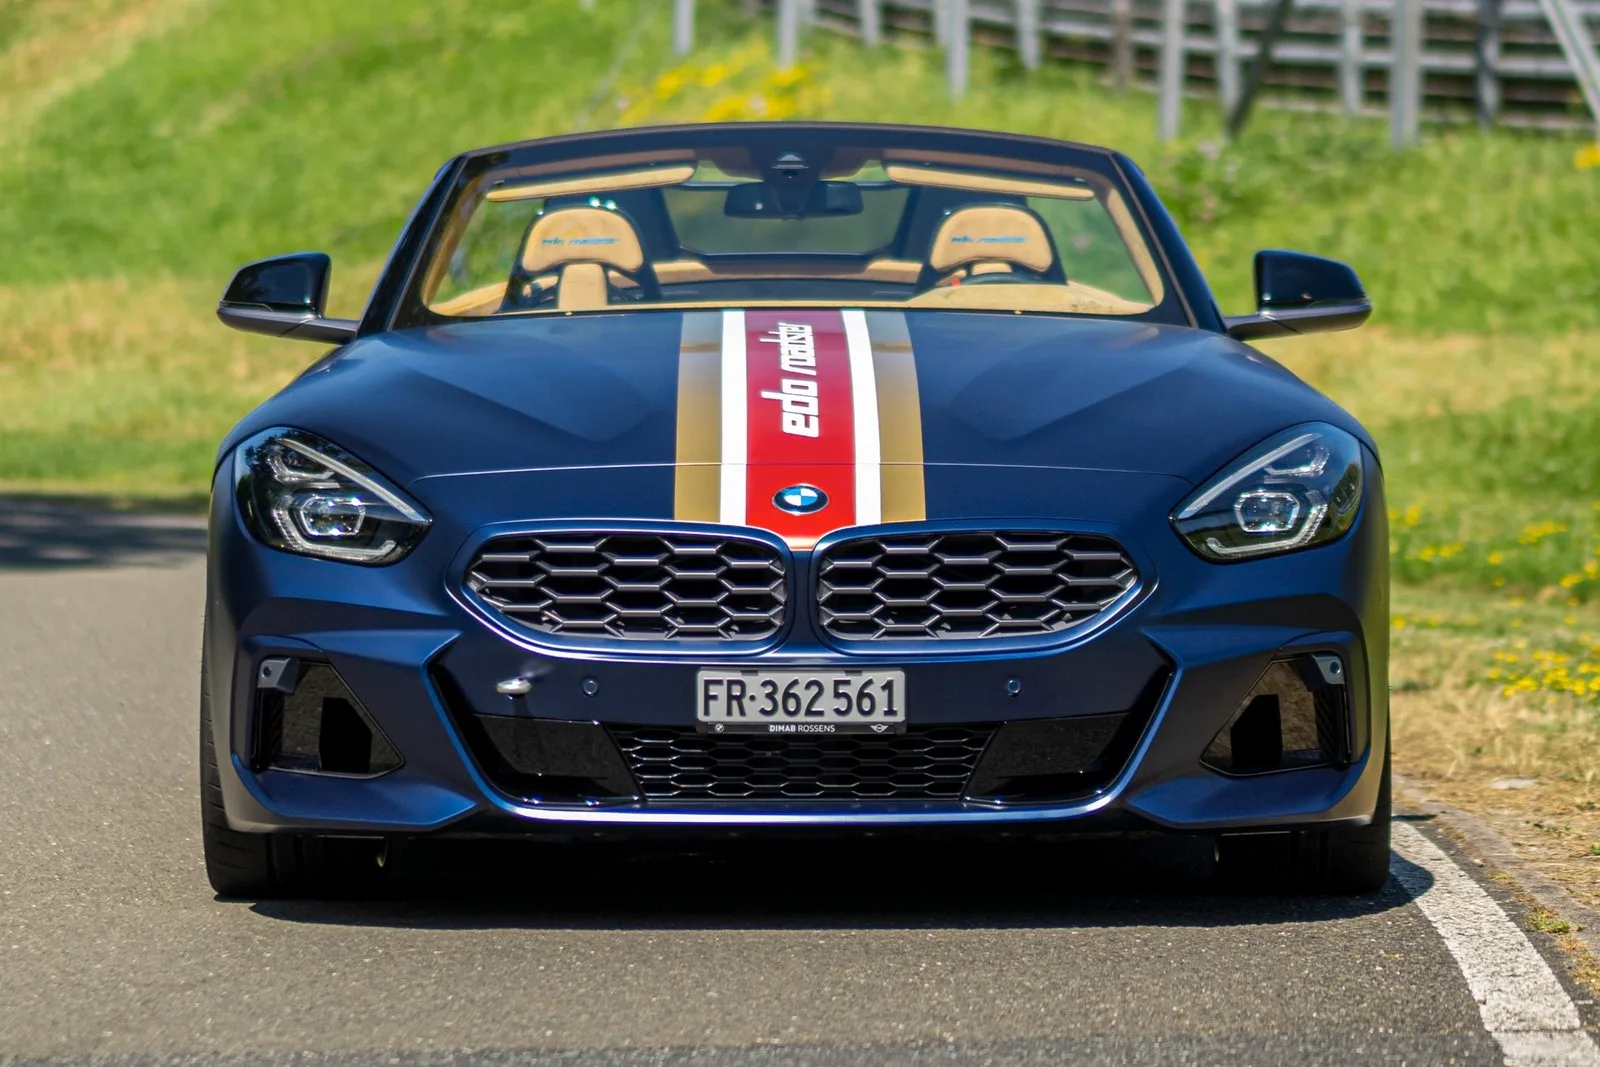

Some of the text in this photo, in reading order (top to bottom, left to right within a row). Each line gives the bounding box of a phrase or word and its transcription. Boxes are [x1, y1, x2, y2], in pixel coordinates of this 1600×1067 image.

[759, 322, 820, 438] edo roadster
[769, 724, 836, 733] DIMAB ROSSENS
